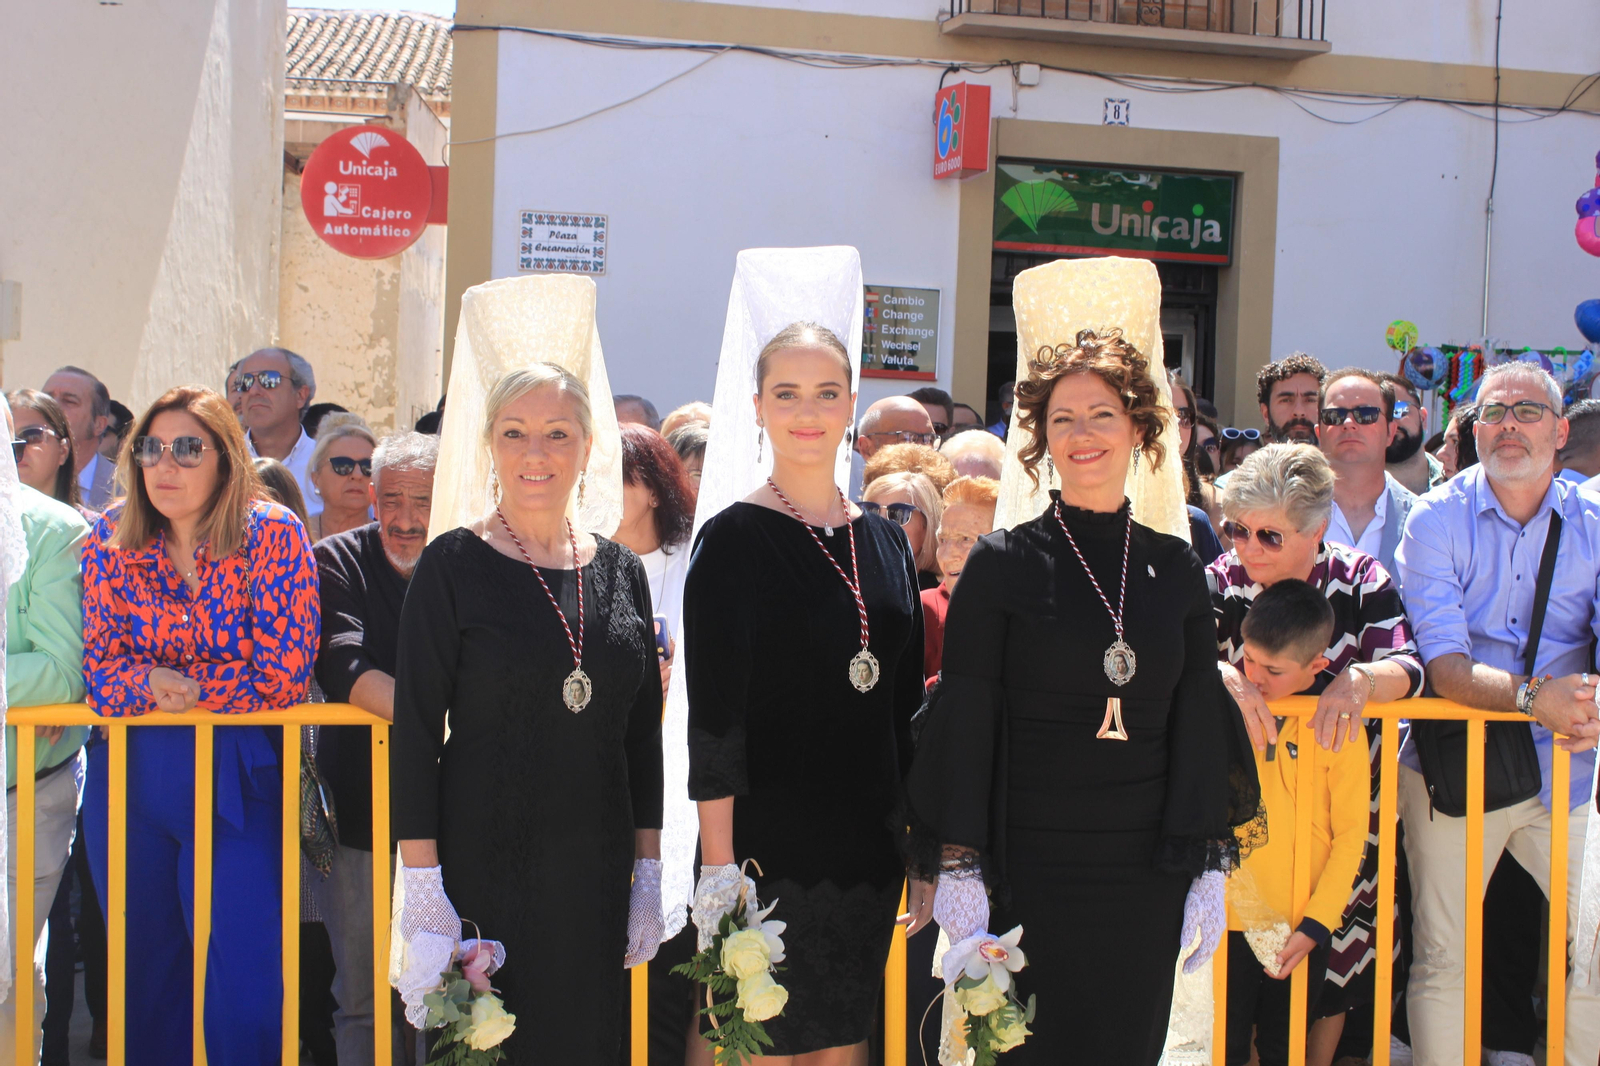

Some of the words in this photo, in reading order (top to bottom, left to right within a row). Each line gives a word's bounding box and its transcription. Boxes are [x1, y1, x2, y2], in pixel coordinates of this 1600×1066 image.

[1113, 104, 1121, 120] 8
[339, 159, 398, 180] Unicaja
[935, 161, 948, 175] EURO
[947, 155, 961, 170] 6000
[361, 206, 412, 220] Cajero
[323, 223, 411, 238] Automático
[1091, 200, 1222, 249] Unicaja
[549, 231, 577, 240] Plaza
[535, 243, 590, 254] Encarnación
[883, 294, 925, 306] Cambio
[882, 309, 924, 323] Change
[881, 324, 935, 339] Exchange
[881, 340, 921, 351] Wechsel
[881, 353, 914, 366] Valuta
